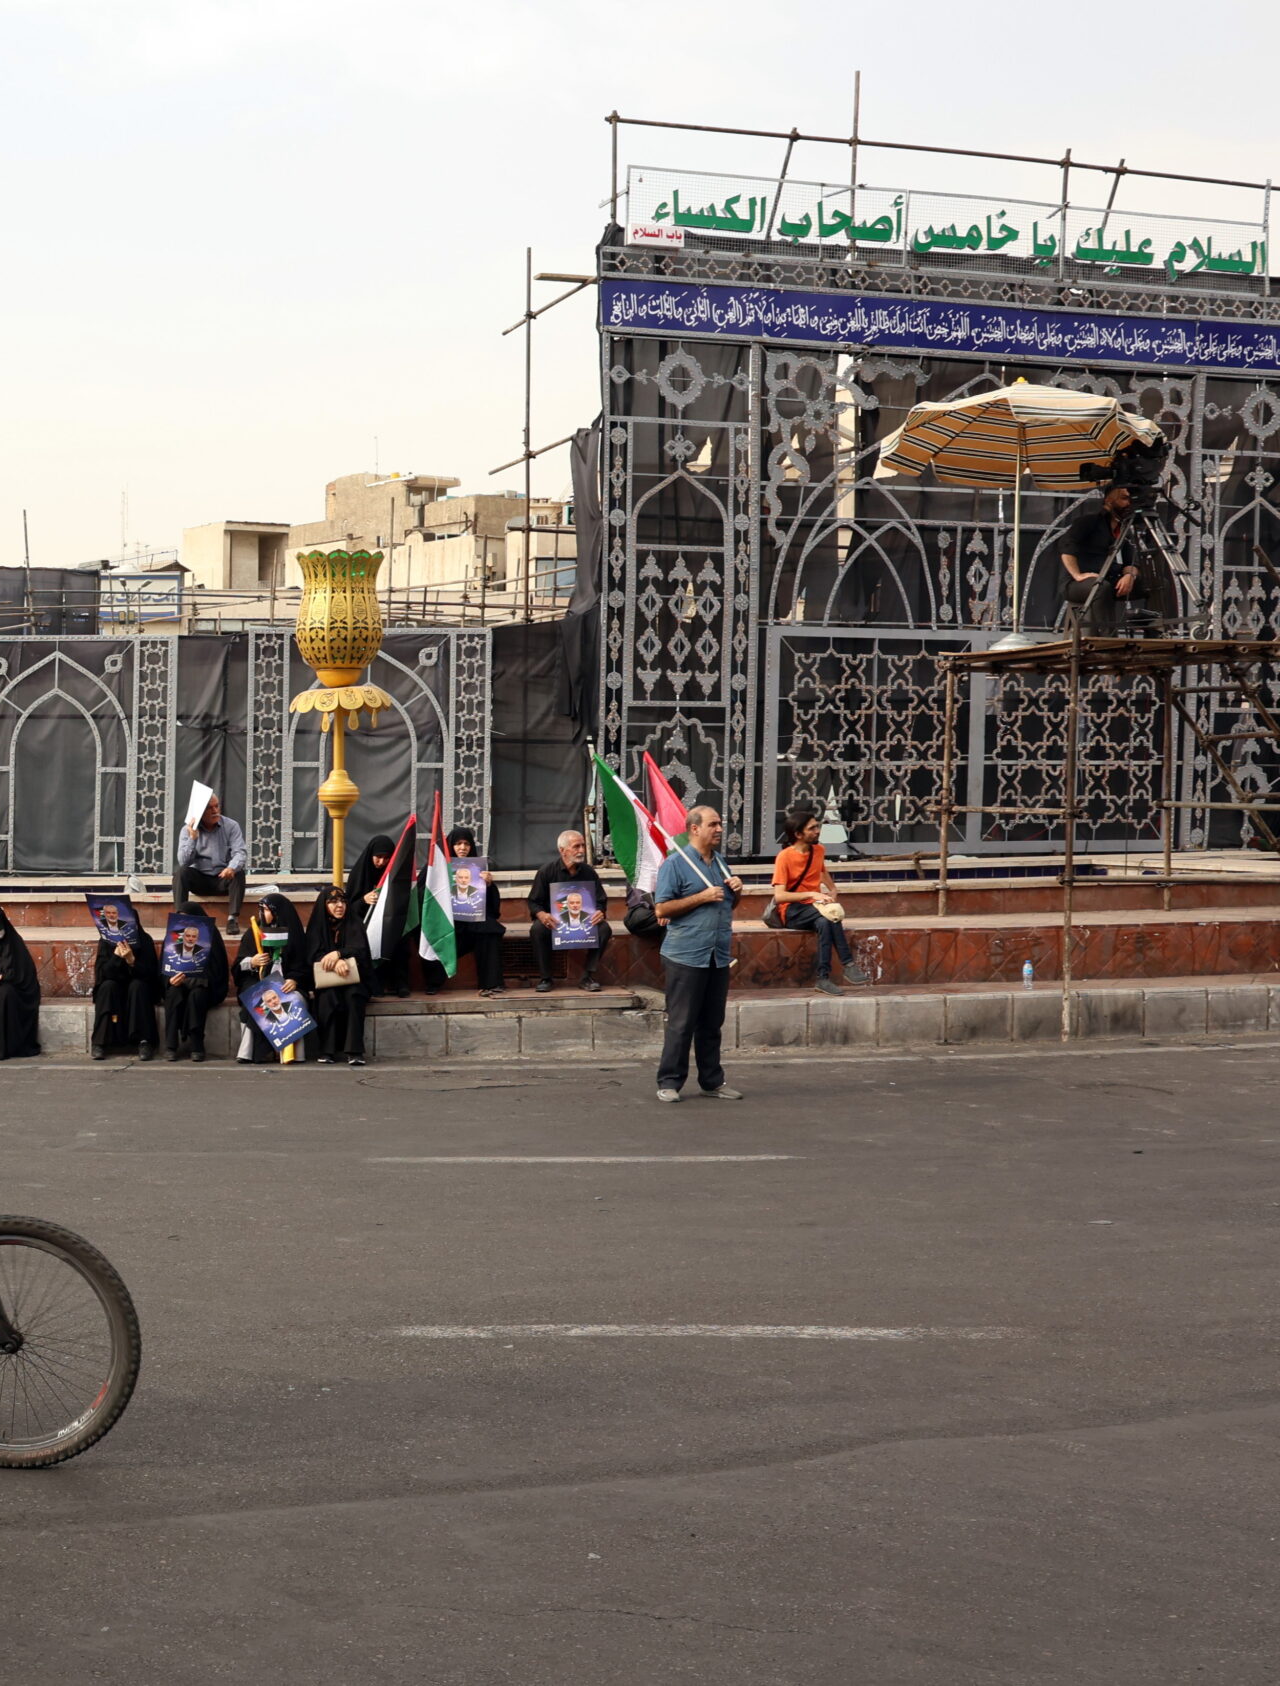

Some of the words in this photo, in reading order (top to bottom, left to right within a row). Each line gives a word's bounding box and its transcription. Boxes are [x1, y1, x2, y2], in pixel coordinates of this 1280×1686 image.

[632, 228, 663, 240] السلام
[653, 189, 767, 234] الكساء
[779, 194, 904, 246] أصحاب
[912, 209, 1019, 253] خامس
[666, 230, 683, 243] باب
[1032, 221, 1057, 268] يا
[1073, 226, 1153, 276] عليك
[1163, 235, 1265, 283] السلام
